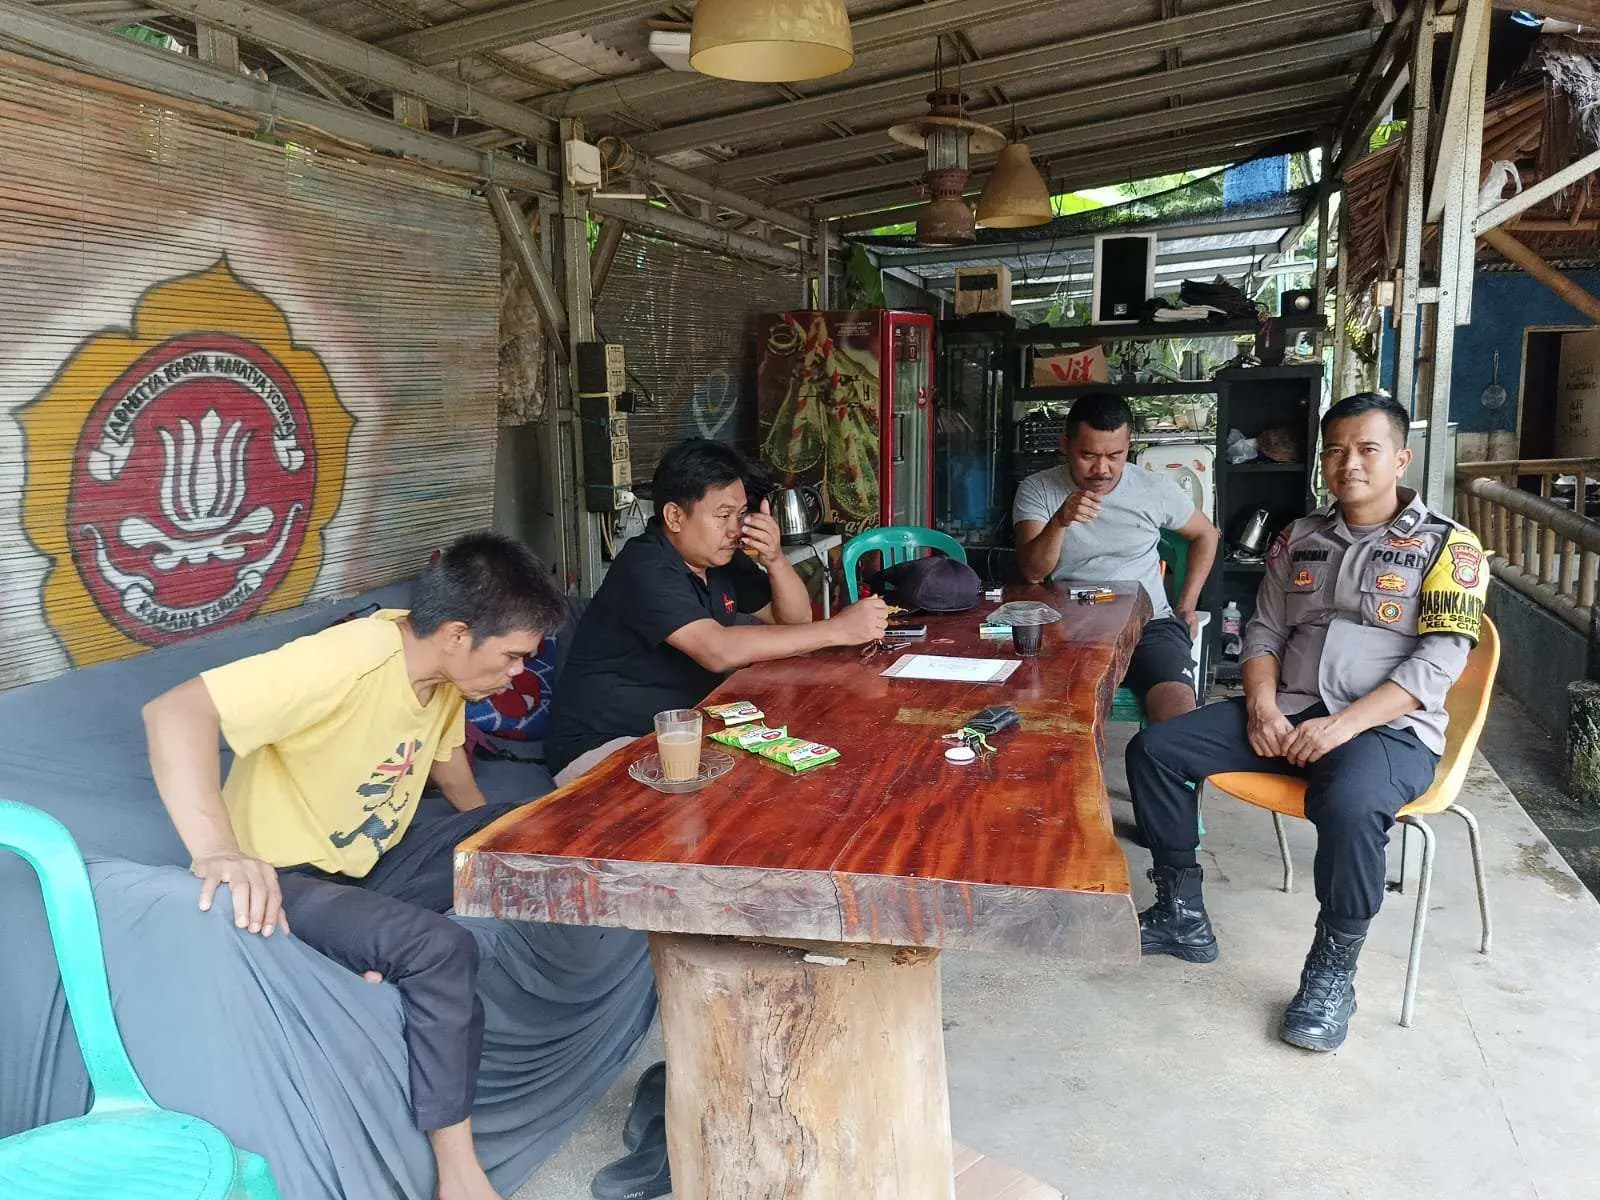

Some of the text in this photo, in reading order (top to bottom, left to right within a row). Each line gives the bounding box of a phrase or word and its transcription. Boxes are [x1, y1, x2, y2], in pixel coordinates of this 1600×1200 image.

[1050, 355, 1095, 381] Vit
[165, 355, 209, 382] KARYA
[265, 386, 295, 434] YODHA
[1371, 550, 1420, 568] POLRI
[1421, 614, 1445, 624] KEC.
[1425, 621, 1451, 629] KEL.
